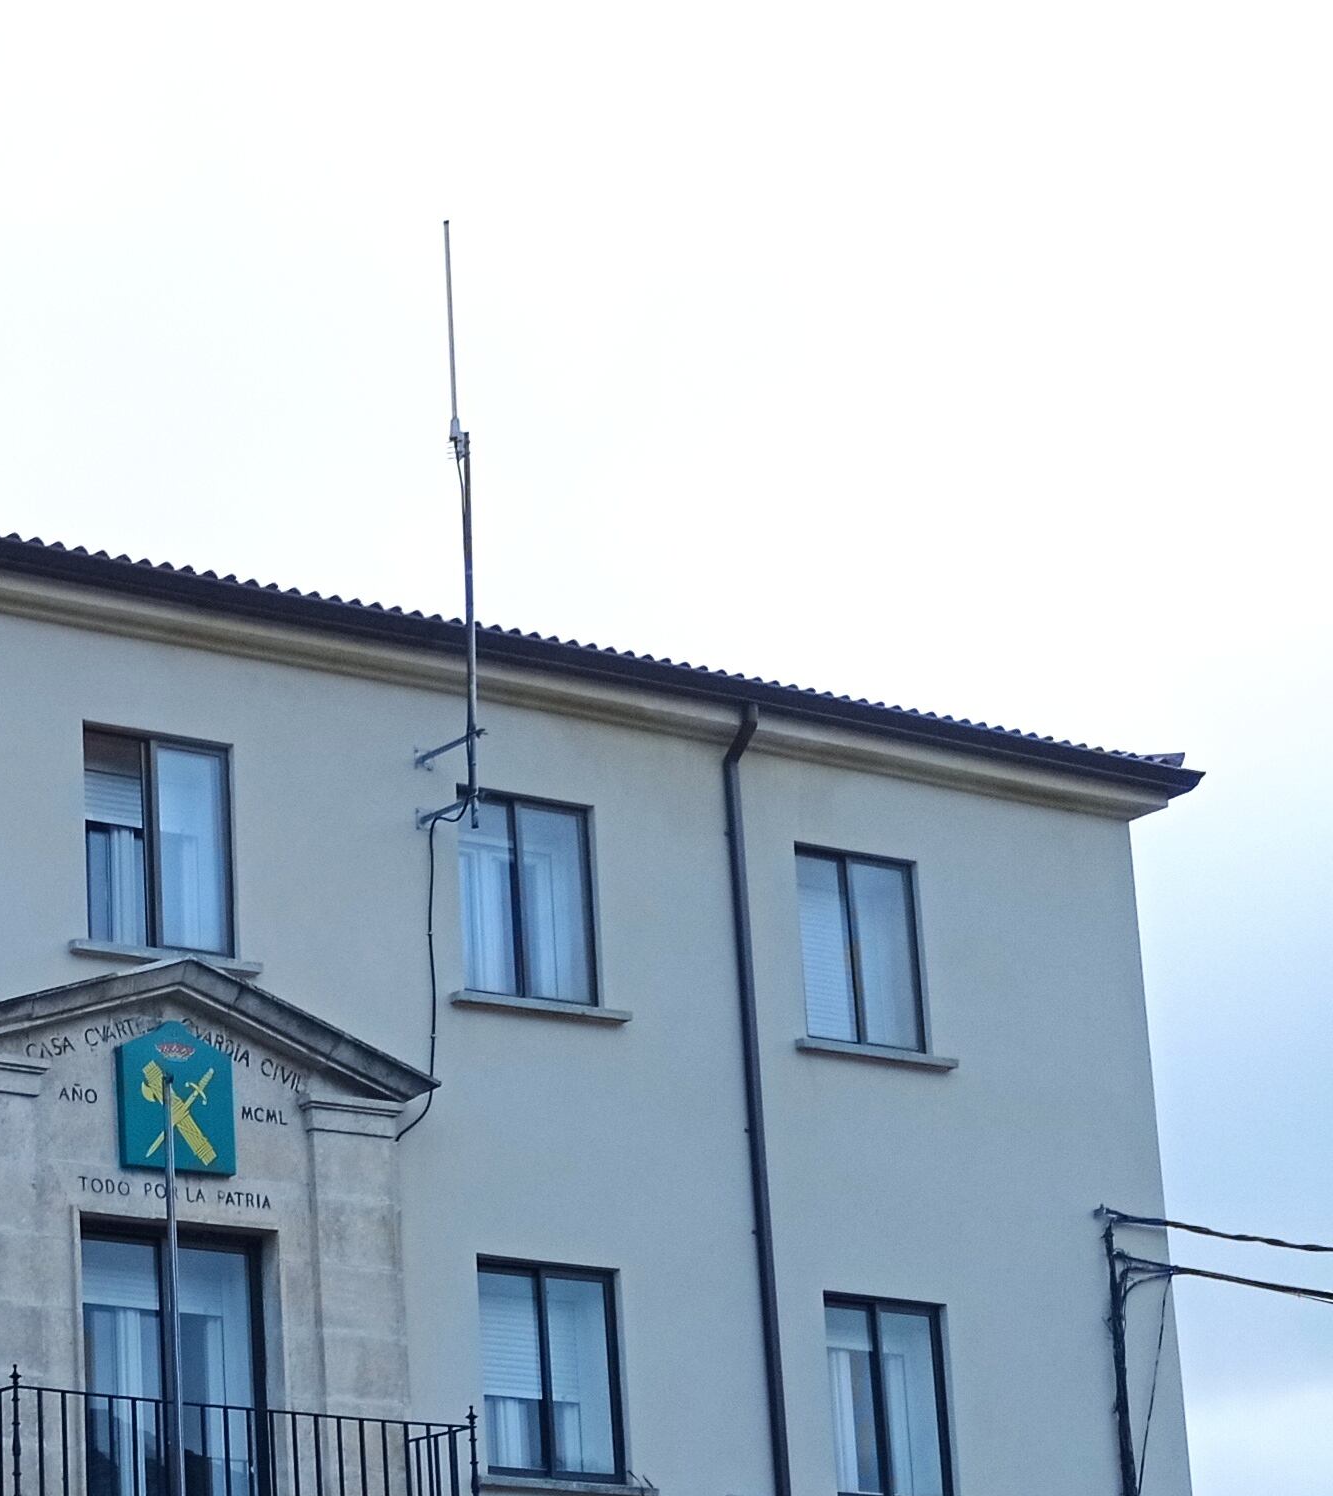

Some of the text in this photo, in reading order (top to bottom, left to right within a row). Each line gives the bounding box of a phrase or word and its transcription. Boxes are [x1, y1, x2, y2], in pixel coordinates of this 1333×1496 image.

[25, 1035, 77, 1059] CASA
[260, 1058, 303, 1095] CIVIL
[59, 1083, 289, 1126] AÑO MCML
[77, 1175, 130, 1196] TODO
[186, 1187, 206, 1203] LA
[217, 1190, 272, 1210] PATRIA
